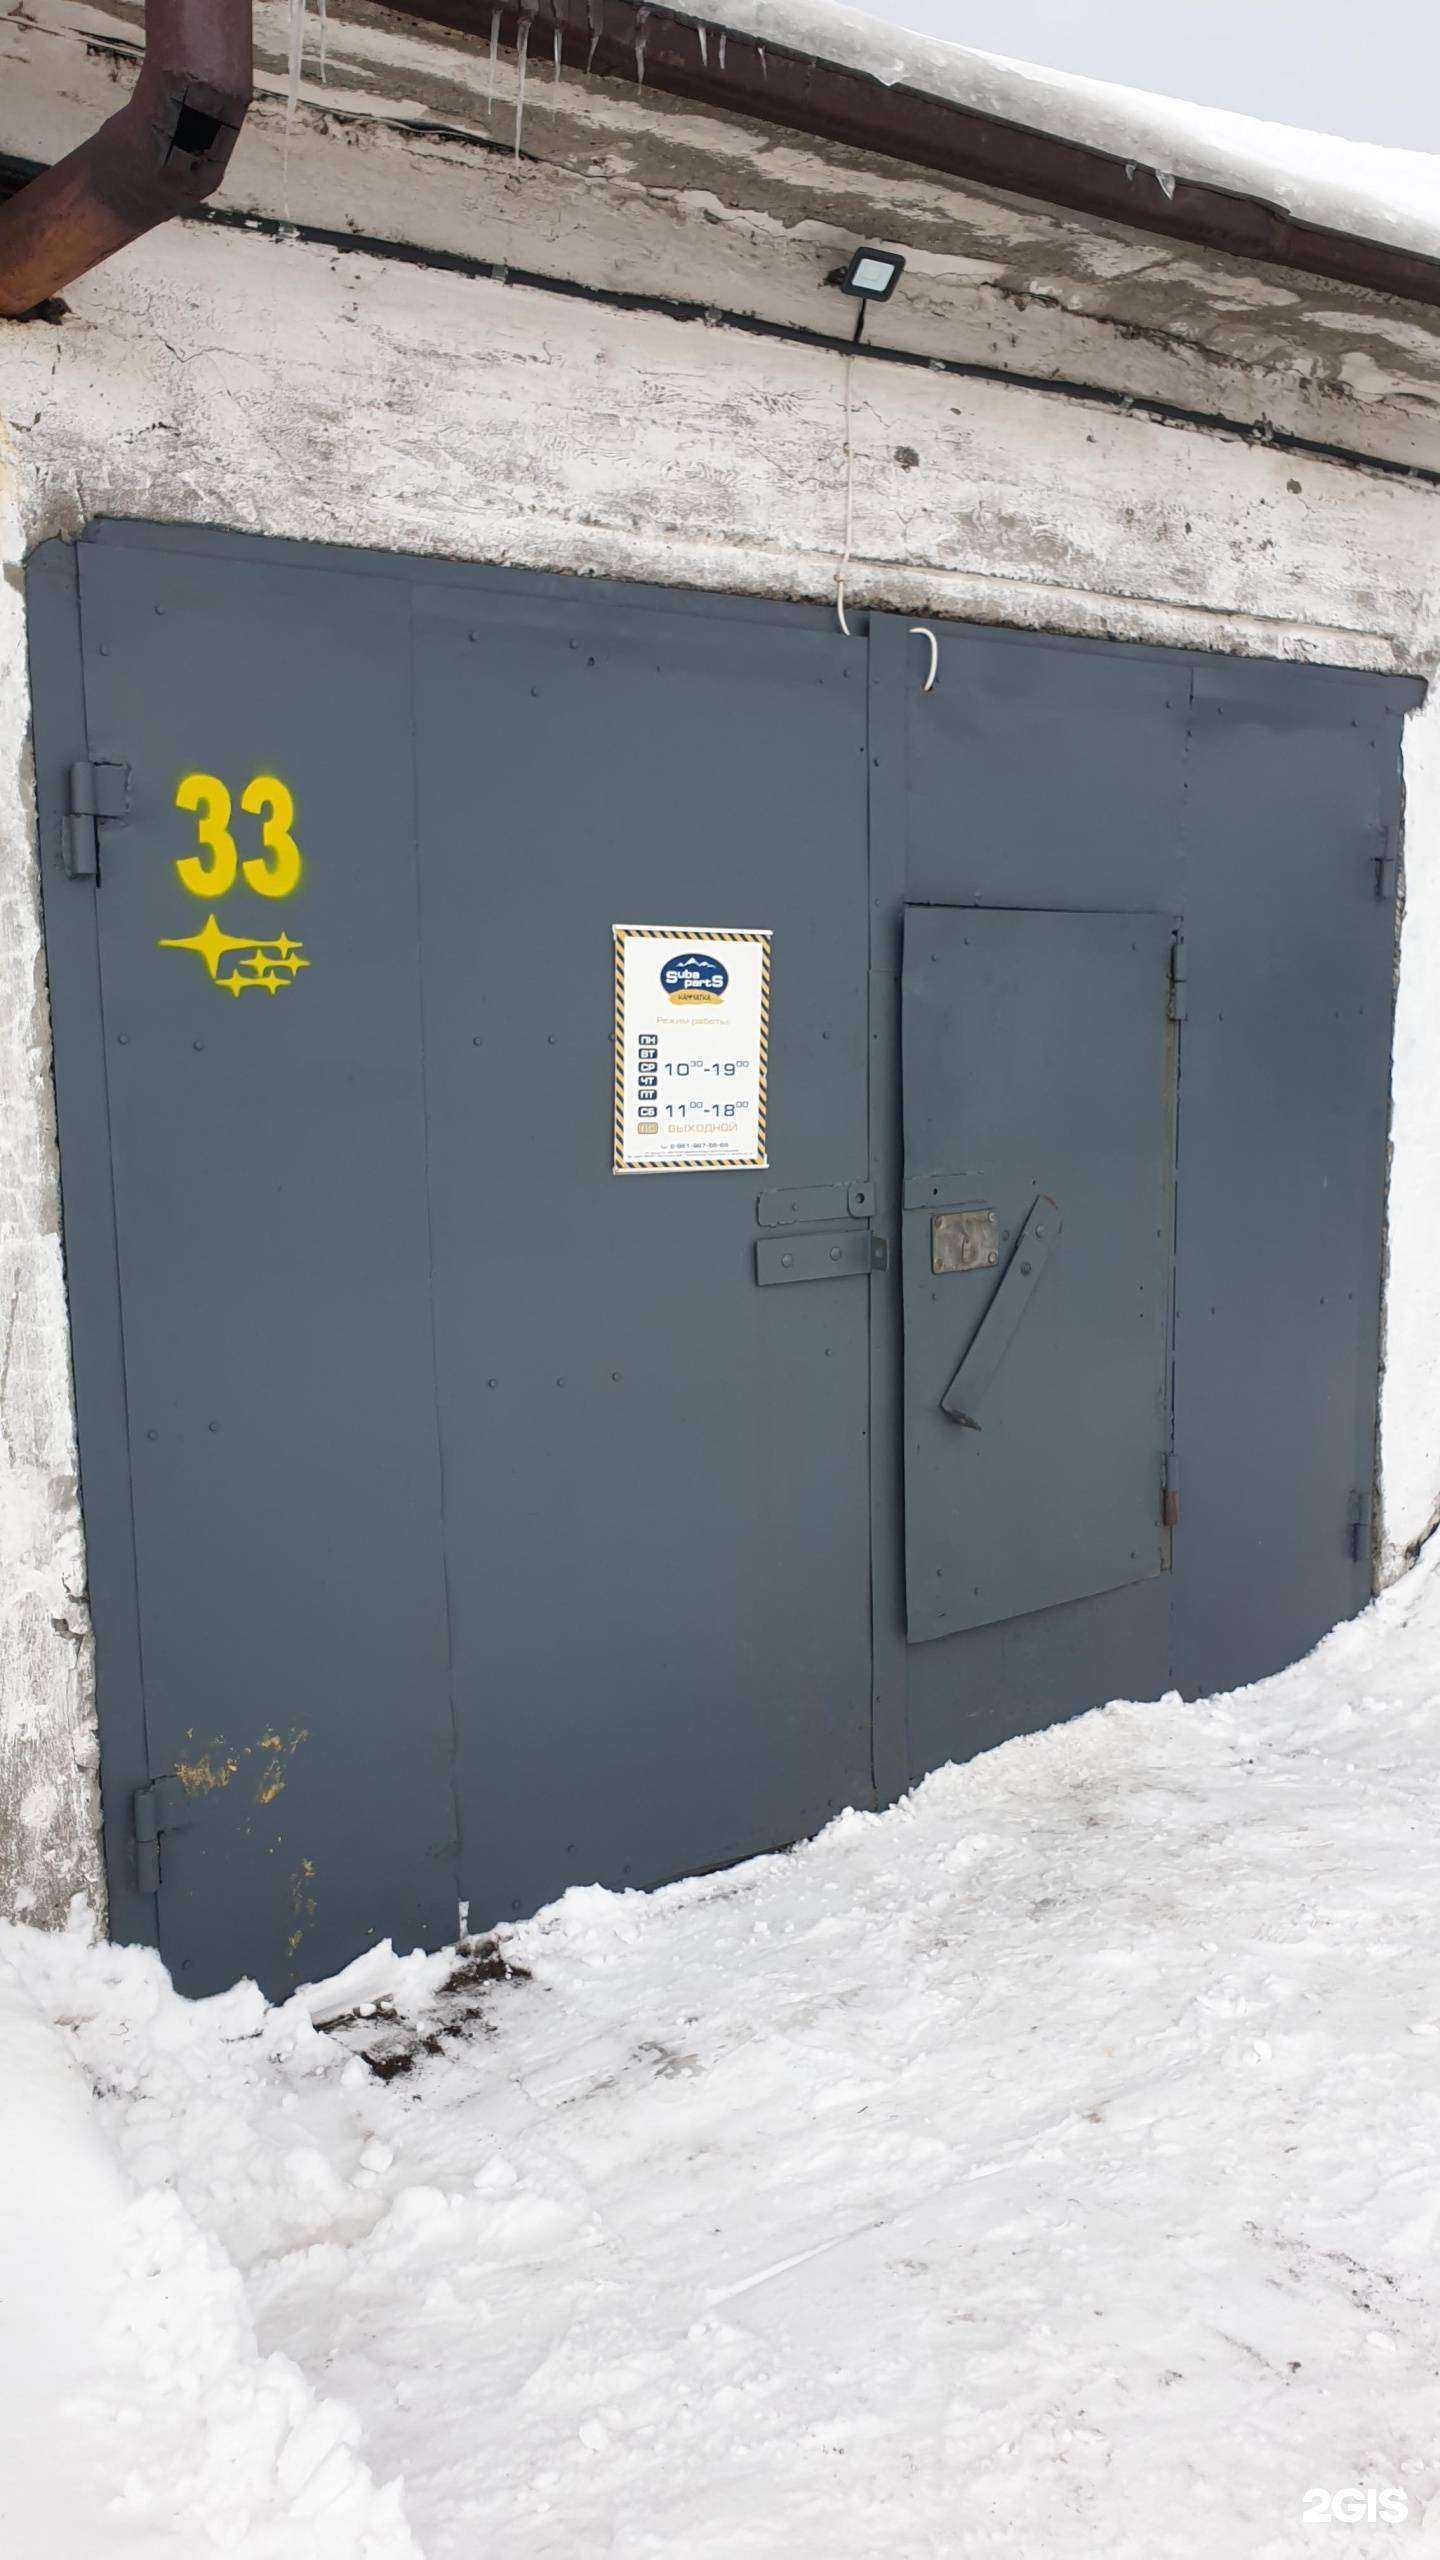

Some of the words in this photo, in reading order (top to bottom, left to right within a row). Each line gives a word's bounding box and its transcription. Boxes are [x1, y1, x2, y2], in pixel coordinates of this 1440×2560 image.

[175, 773, 301, 898] 33
[665, 969, 700, 984] Suba
[640, 1036, 656, 1044] ПН
[640, 1050, 656, 1058] ВТ
[640, 1063, 656, 1071] СР
[640, 1077, 656, 1086] ЧТ
[640, 1091, 656, 1099] ПТ
[640, 1108, 656, 1116] СБ
